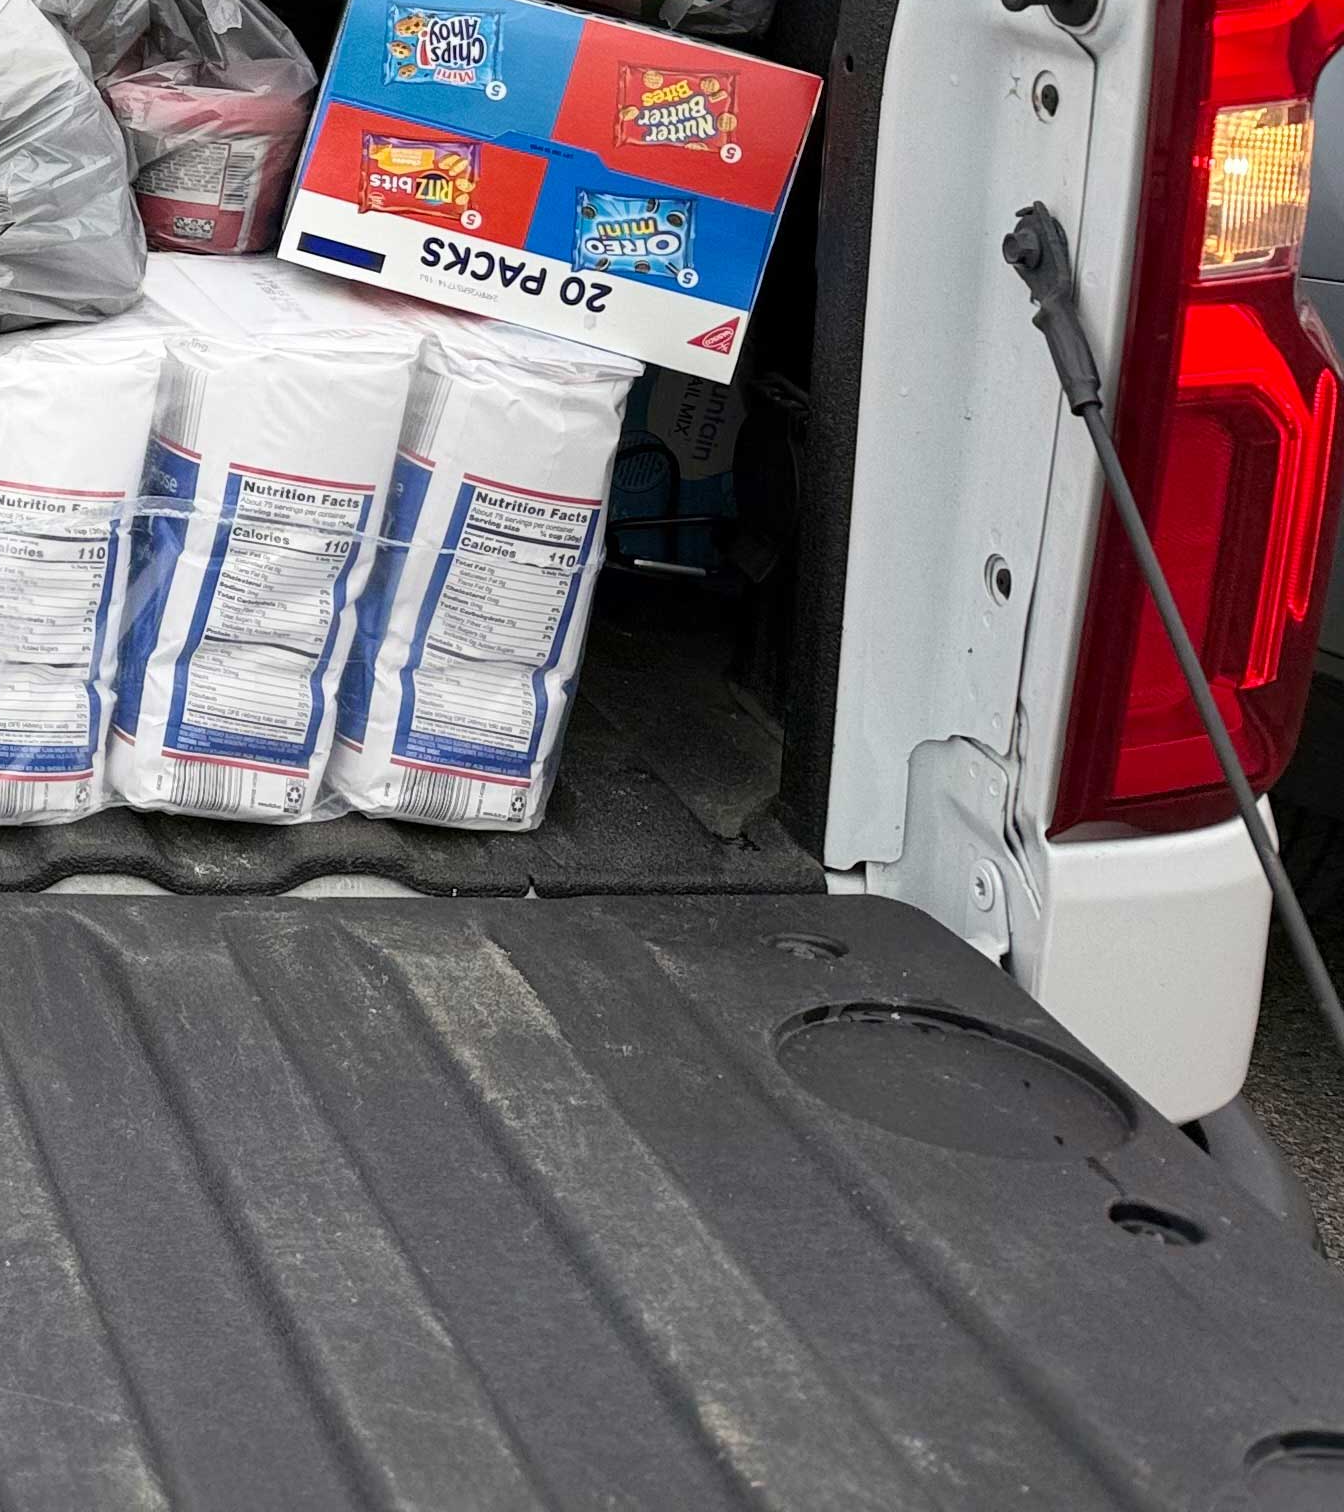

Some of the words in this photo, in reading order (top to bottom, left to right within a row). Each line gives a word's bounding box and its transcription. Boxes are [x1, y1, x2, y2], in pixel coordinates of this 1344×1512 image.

[430, 37, 485, 66] Chips
[438, 69, 474, 83] Mini
[491, 85, 502, 97] 5
[641, 80, 693, 106] Bites
[638, 96, 707, 125] Butter
[645, 115, 715, 142] Nutter
[725, 147, 737, 159] 5
[369, 174, 412, 194] bits
[415, 178, 454, 203] RITZ
[466, 213, 476, 226] 5
[597, 216, 657, 237] mini
[585, 231, 681, 256] OREO
[420, 237, 548, 296] PACKS
[682, 271, 694, 284] 5
[559, 276, 612, 312] 20
[243, 480, 316, 504] Nutrition
[322, 494, 360, 509] Facts
[475, 491, 545, 517] Nutrition
[551, 509, 588, 524] Facts
[469, 514, 501, 529] Serving
[233, 526, 290, 545] Calories
[324, 540, 349, 554] 110
[461, 537, 517, 558] Calories
[549, 553, 575, 568] 110
[78, 547, 106, 560] 110
